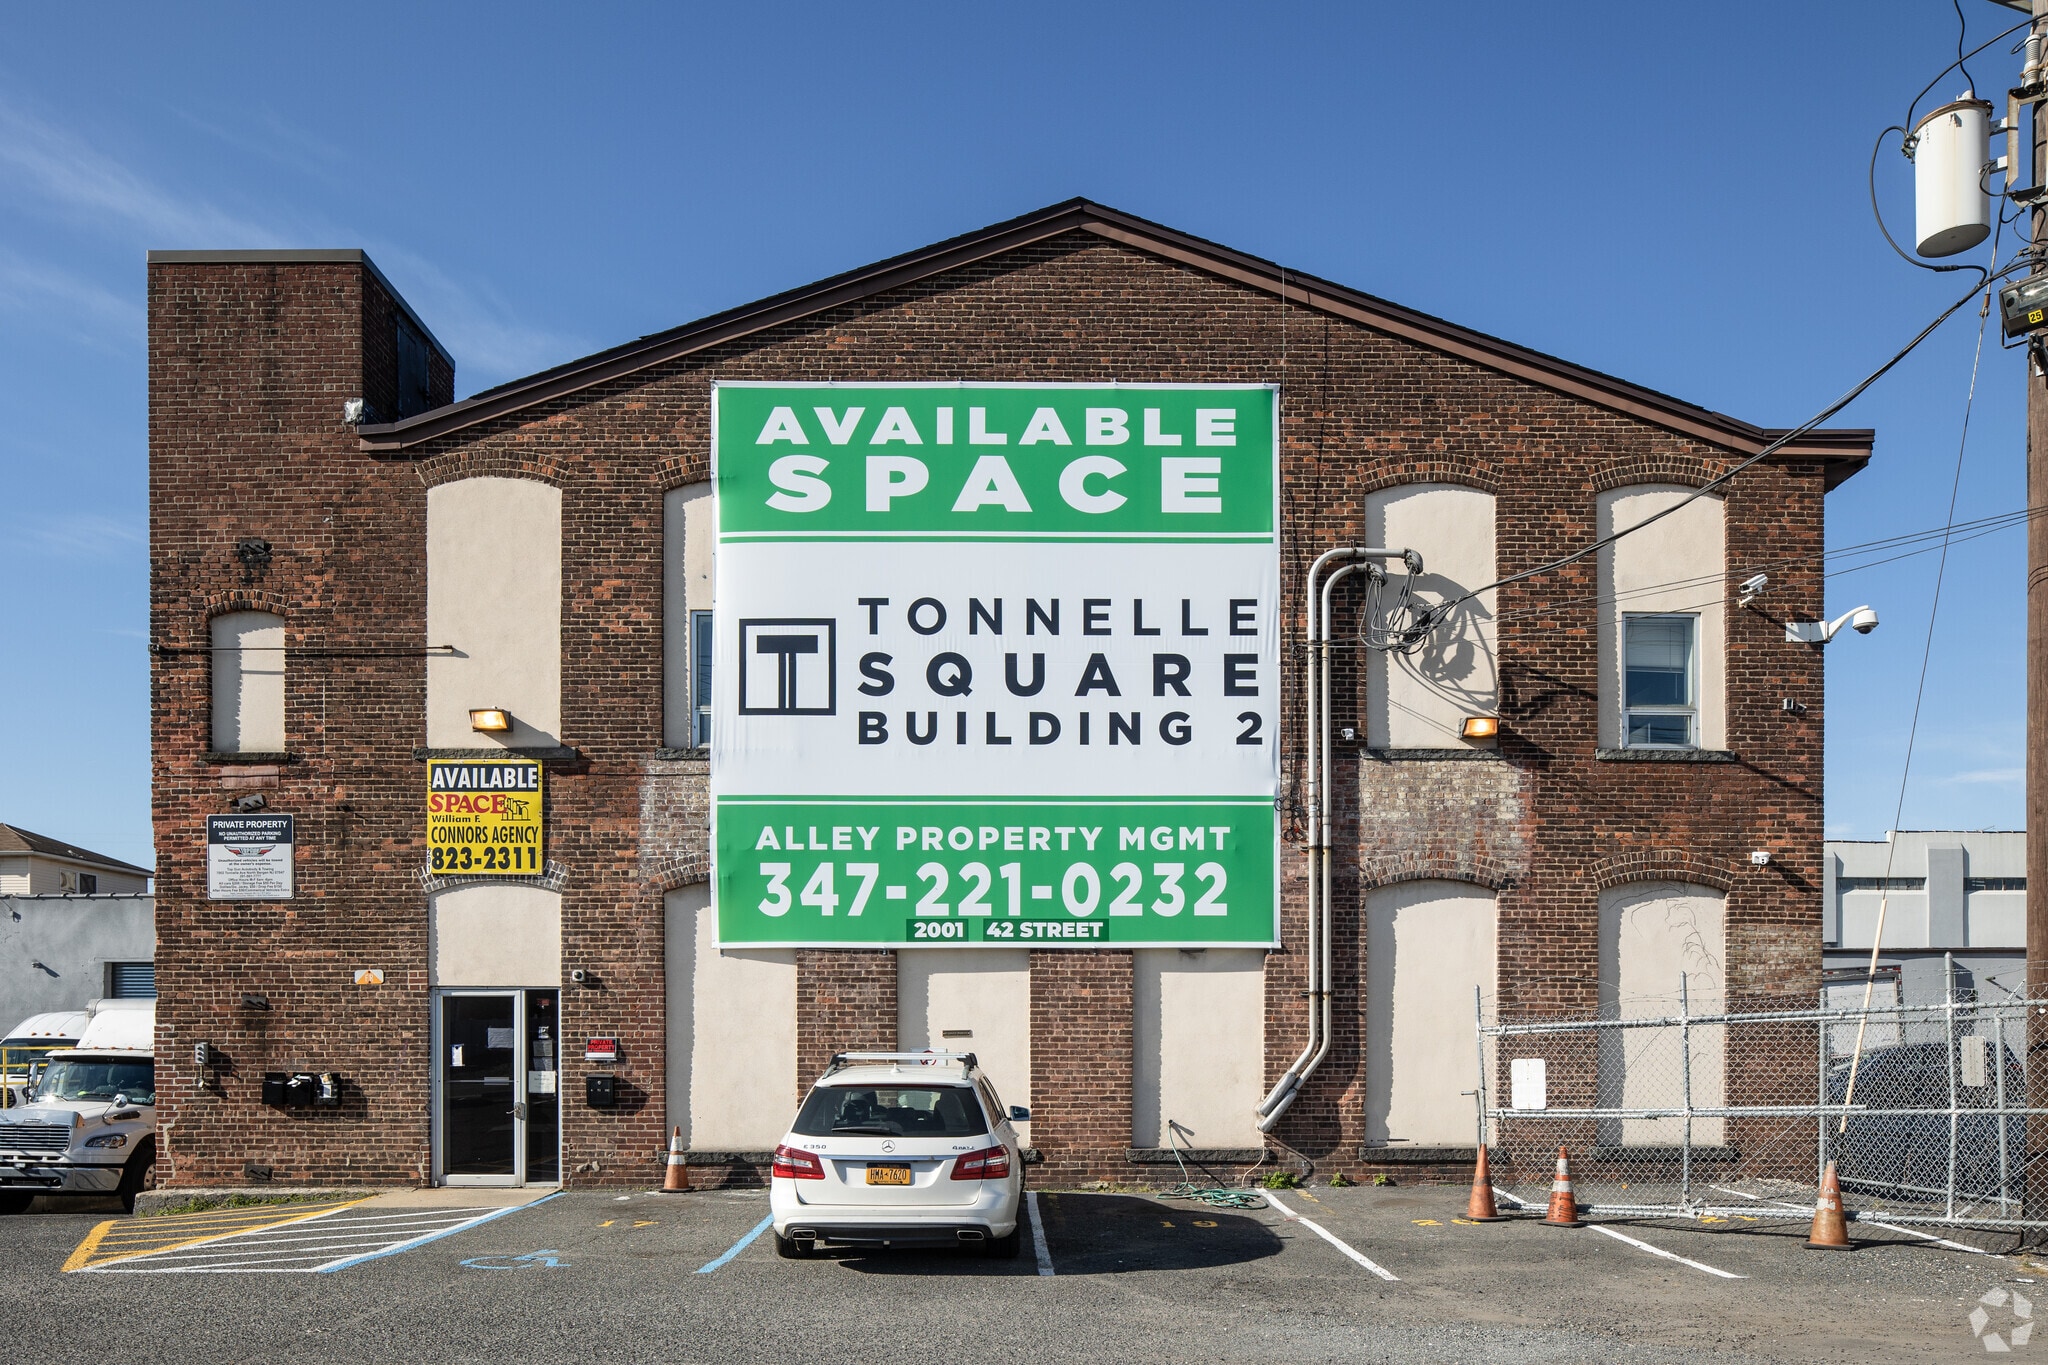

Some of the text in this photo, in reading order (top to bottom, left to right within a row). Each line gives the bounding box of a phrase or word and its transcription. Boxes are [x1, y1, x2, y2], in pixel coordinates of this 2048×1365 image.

[2029, 311, 2042, 322] 25
[755, 406, 1237, 447] AVAILABLE
[765, 455, 1222, 514] SPACE
[858, 597, 1258, 636] TONNELLE
[857, 652, 1259, 698] SQUARE
[858, 711, 1263, 746] BUILDING 2
[432, 767, 538, 789] AVAILABLE
[428, 794, 508, 814] SPACE
[213, 820, 287, 828] PRIVATE PROPERTY
[432, 815, 481, 823] William F.
[431, 826, 539, 844] CONNORS AGENCY
[756, 826, 1231, 851] ALLEY PROPERTY MGMT
[432, 847, 536, 870] 823-2311
[757, 862, 1228, 918] 347-221-0232
[914, 921, 1104, 938] 2001 42 STREET
